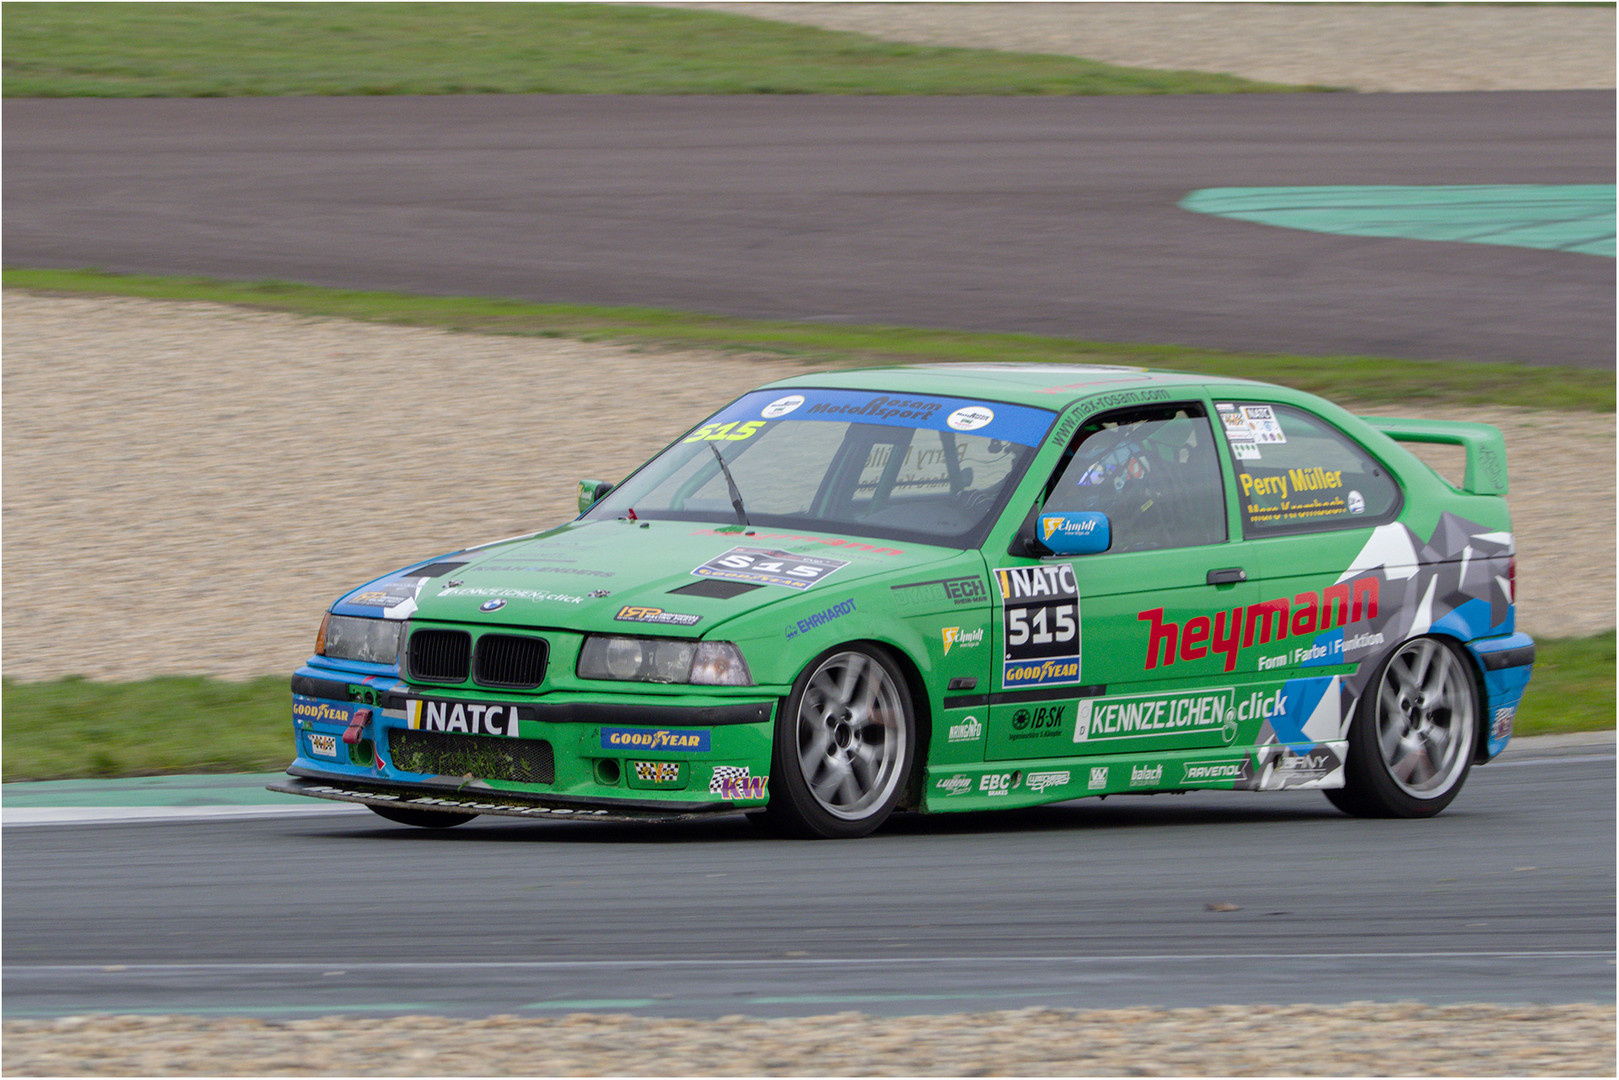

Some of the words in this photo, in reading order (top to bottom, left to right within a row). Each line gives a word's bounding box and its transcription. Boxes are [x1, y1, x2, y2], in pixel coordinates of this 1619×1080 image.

[682, 420, 767, 443] 515
[1052, 388, 1172, 447] www.max-rosam.com
[1239, 473, 1288, 499] Perry
[1288, 466, 1343, 492] Müller
[718, 555, 823, 578] 515
[1010, 566, 1076, 598] NATC
[546, 594, 584, 604] click
[796, 598, 856, 634] EHRHARDT
[1009, 604, 1076, 646] 515
[1137, 576, 1380, 673] heymann
[1258, 655, 1287, 671] Form
[1294, 644, 1327, 664] Farbe
[1334, 632, 1384, 654] Funktion
[1006, 661, 1078, 682] GOODYEAR
[293, 703, 349, 721] GOODYEAR
[426, 701, 503, 735] NATC
[1091, 696, 1226, 734] KENNZEICHEN
[1237, 689, 1288, 721] click
[610, 731, 700, 748] GOODYEAR
[721, 776, 769, 800] KW
[979, 774, 1011, 790] EBC
